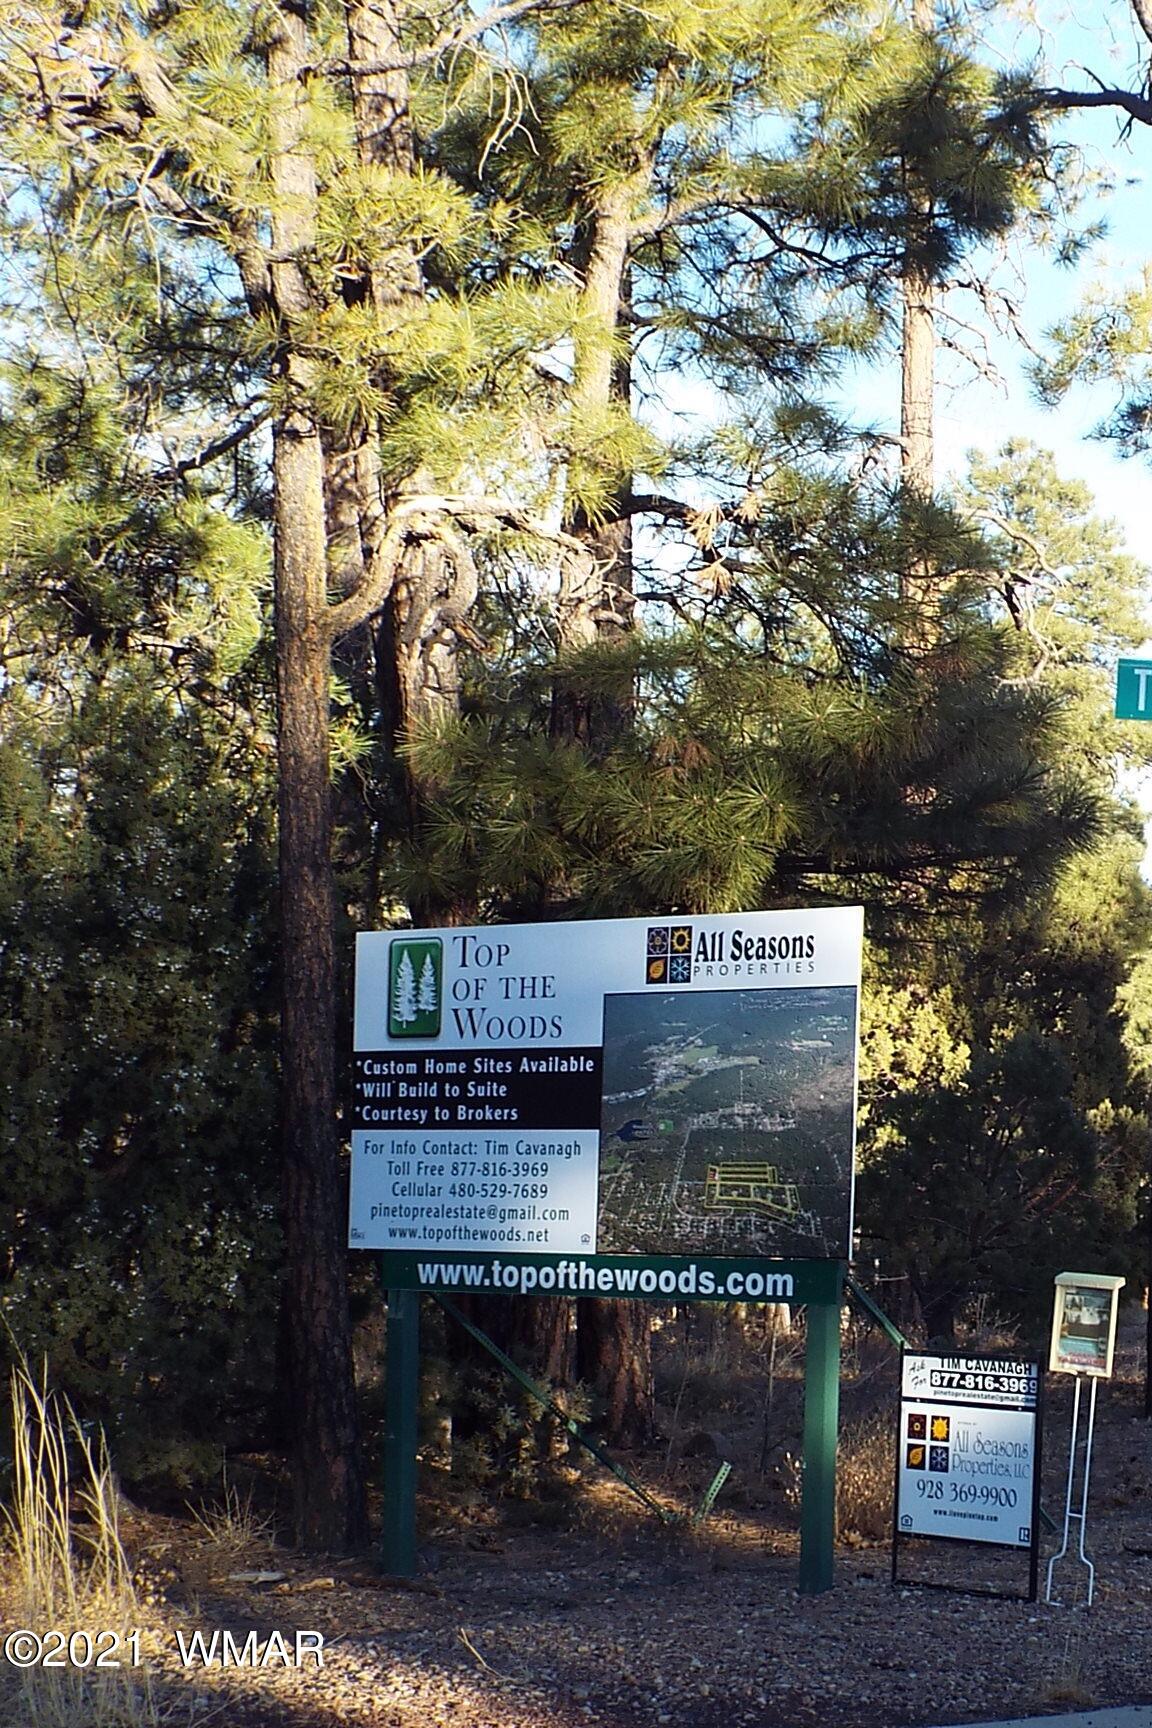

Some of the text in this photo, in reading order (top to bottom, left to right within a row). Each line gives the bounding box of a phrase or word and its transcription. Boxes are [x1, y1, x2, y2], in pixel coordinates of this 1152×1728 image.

[694, 930, 815, 962] All Seasons
[693, 961, 815, 976] PROPERTIES
[452, 975, 556, 1001] OF THE
[425, 1058, 467, 1074] Home
[473, 1058, 512, 1073] Sites
[519, 1056, 595, 1073] Available
[398, 1081, 438, 1097] Build
[445, 1083, 460, 1097] to
[466, 1081, 507, 1097] Suite
[434, 1106, 450, 1120] to
[457, 1105, 518, 1121] Brokers
[364, 1140, 581, 1159] For Info Contact: Tim Cavanagh
[387, 1161, 549, 1177] Toll Free 877-816-3969
[391, 1181, 548, 1198] Cellular 480-529-7689
[370, 1203, 569, 1222] pinetoprealestate@gmail.com
[388, 1226, 549, 1243] www.topofthewoods.net
[417, 1260, 794, 1297] www.topofthewoods.com
[940, 1358, 1033, 1376] TIM CAVANAGH
[931, 1371, 1037, 1394] 877-816-3969
[953, 1430, 1029, 1459] All Seasons
[917, 1479, 1018, 1508] 928 369-9900
